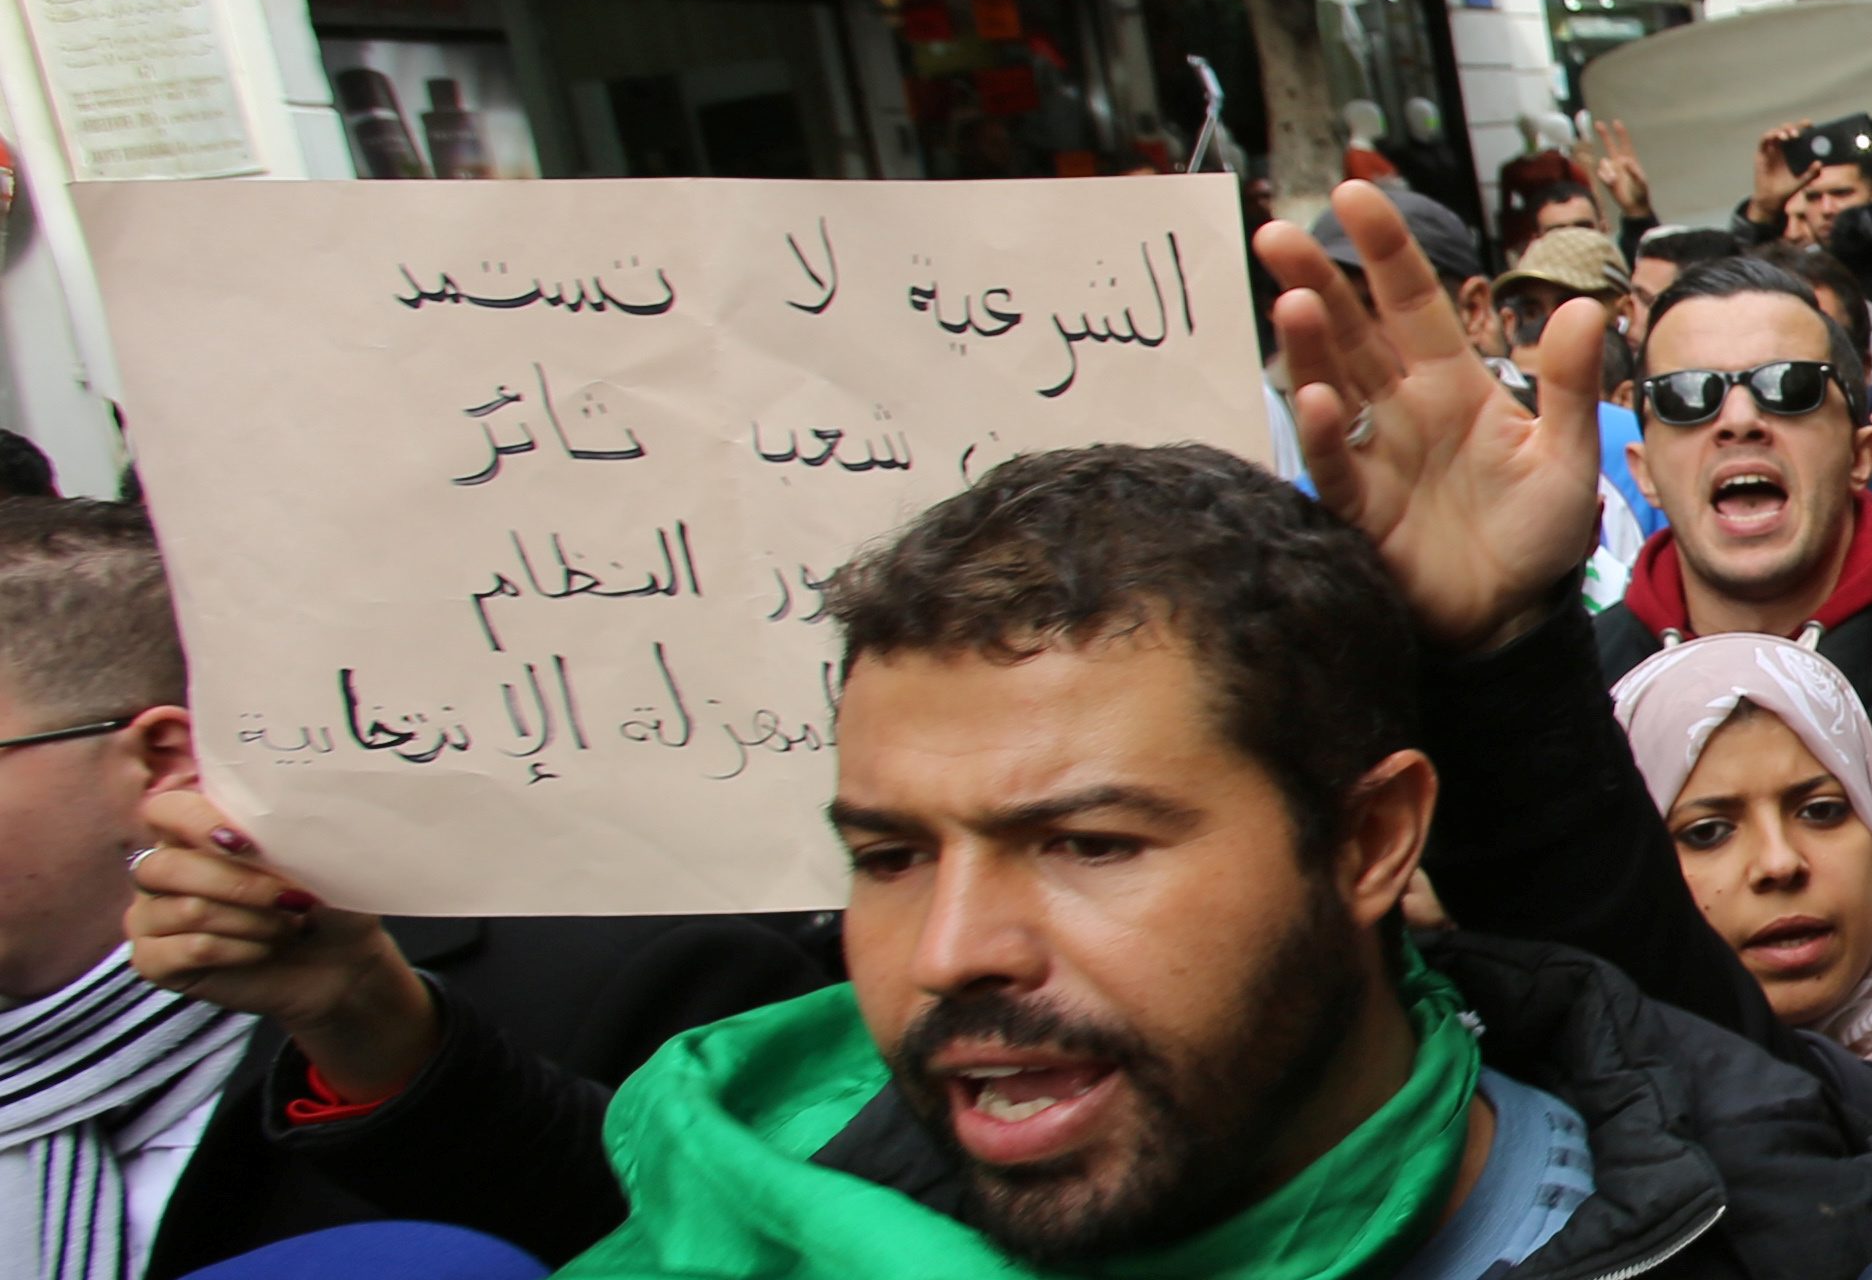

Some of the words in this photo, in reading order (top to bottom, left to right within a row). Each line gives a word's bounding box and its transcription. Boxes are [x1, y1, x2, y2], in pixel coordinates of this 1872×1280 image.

[394, 255, 675, 316] تستمد
[785, 216, 838, 314] لا
[909, 232, 1195, 397] الشرعية
[450, 362, 648, 486] ثائر
[752, 403, 912, 486] شعب
[471, 519, 704, 652] النظام
